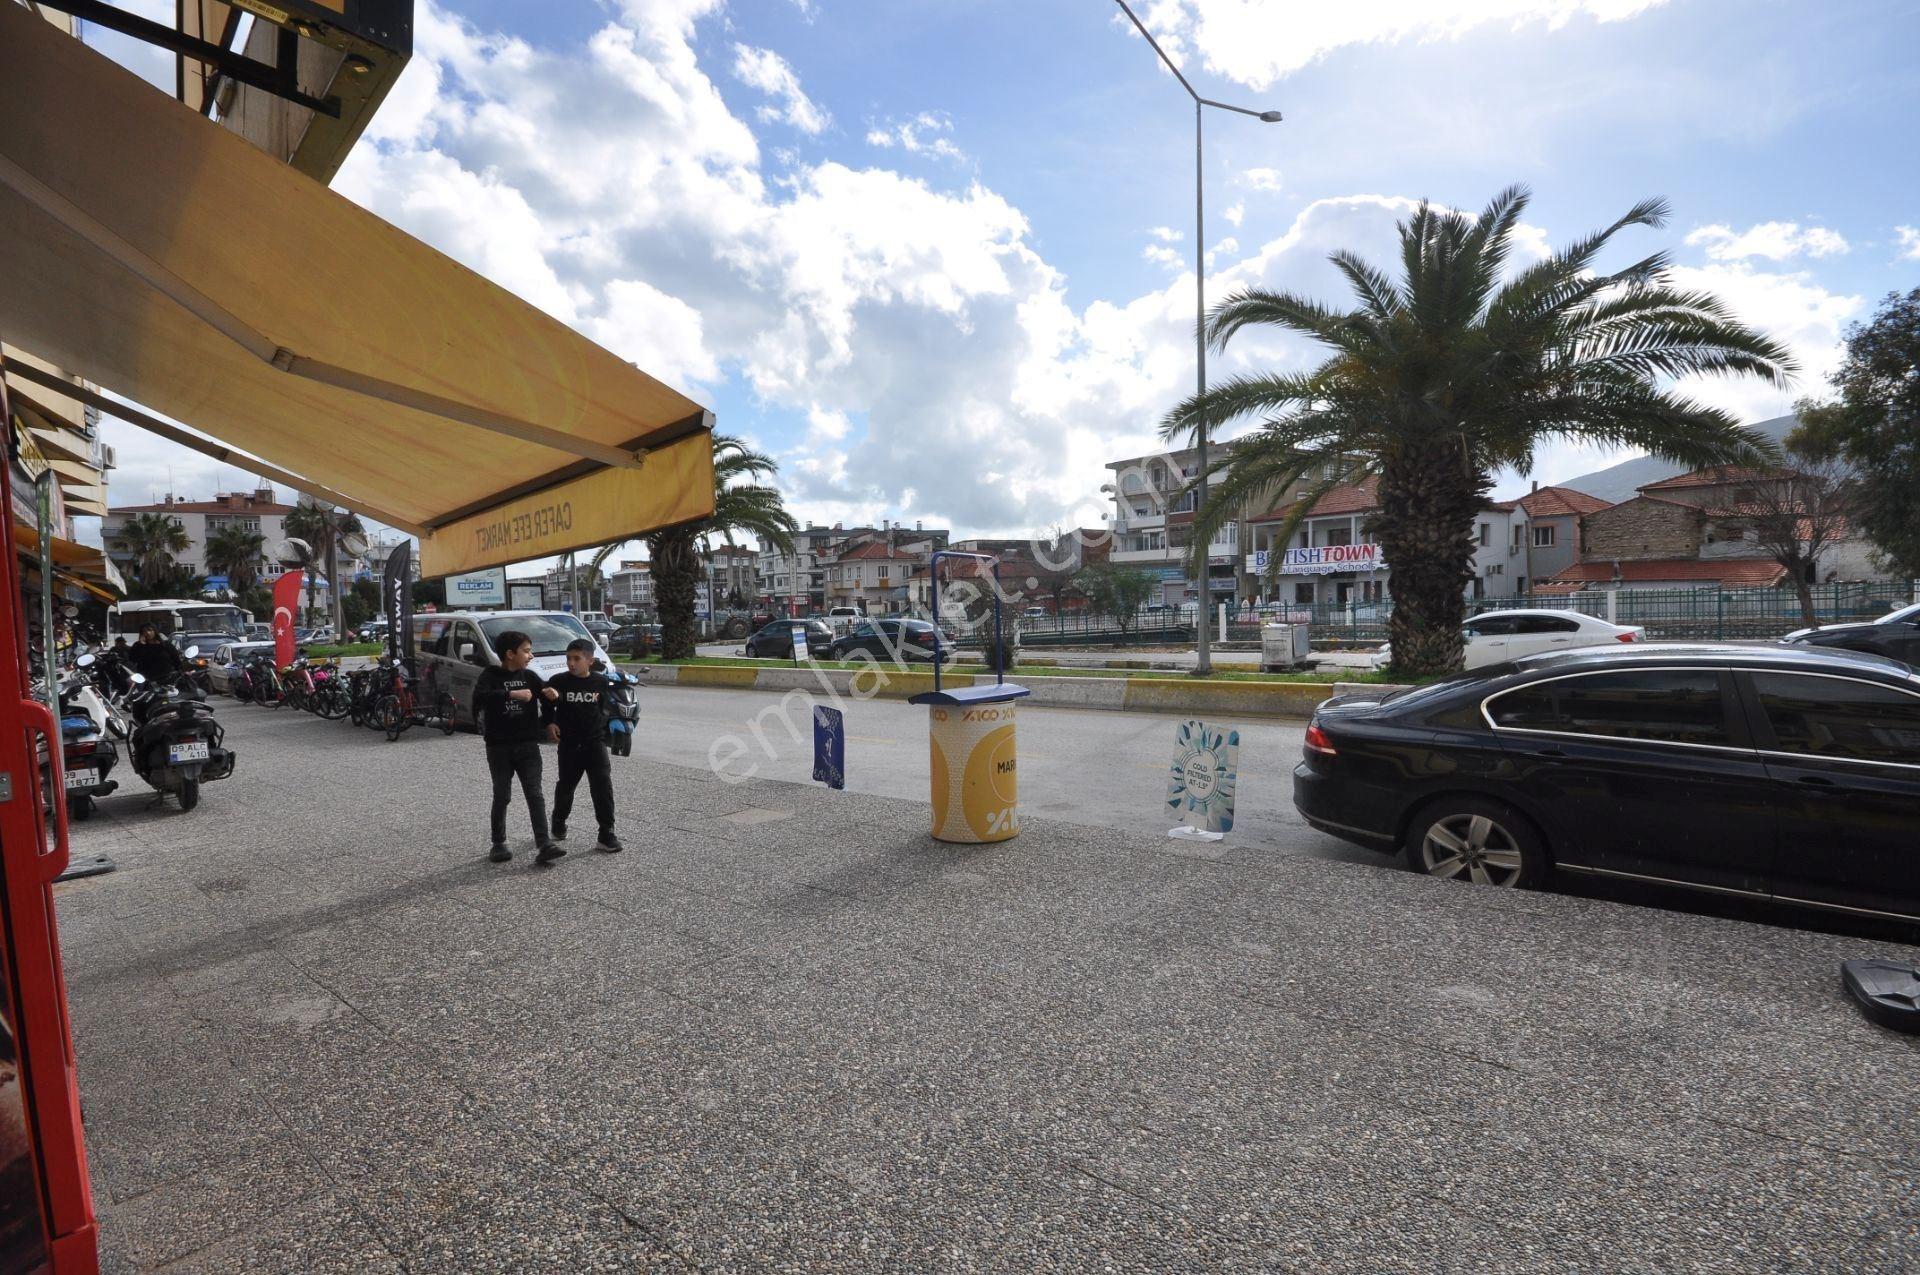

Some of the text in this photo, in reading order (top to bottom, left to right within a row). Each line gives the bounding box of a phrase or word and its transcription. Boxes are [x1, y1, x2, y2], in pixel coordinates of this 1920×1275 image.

[1287, 564, 1334, 575] Language
[1337, 561, 1376, 572] Schools
[566, 691, 600, 703] BACK
[171, 745, 185, 753] 09
[189, 751, 207, 759] 410
[1192, 762, 1208, 773] COLD
[1187, 769, 1212, 783] FILTERED
